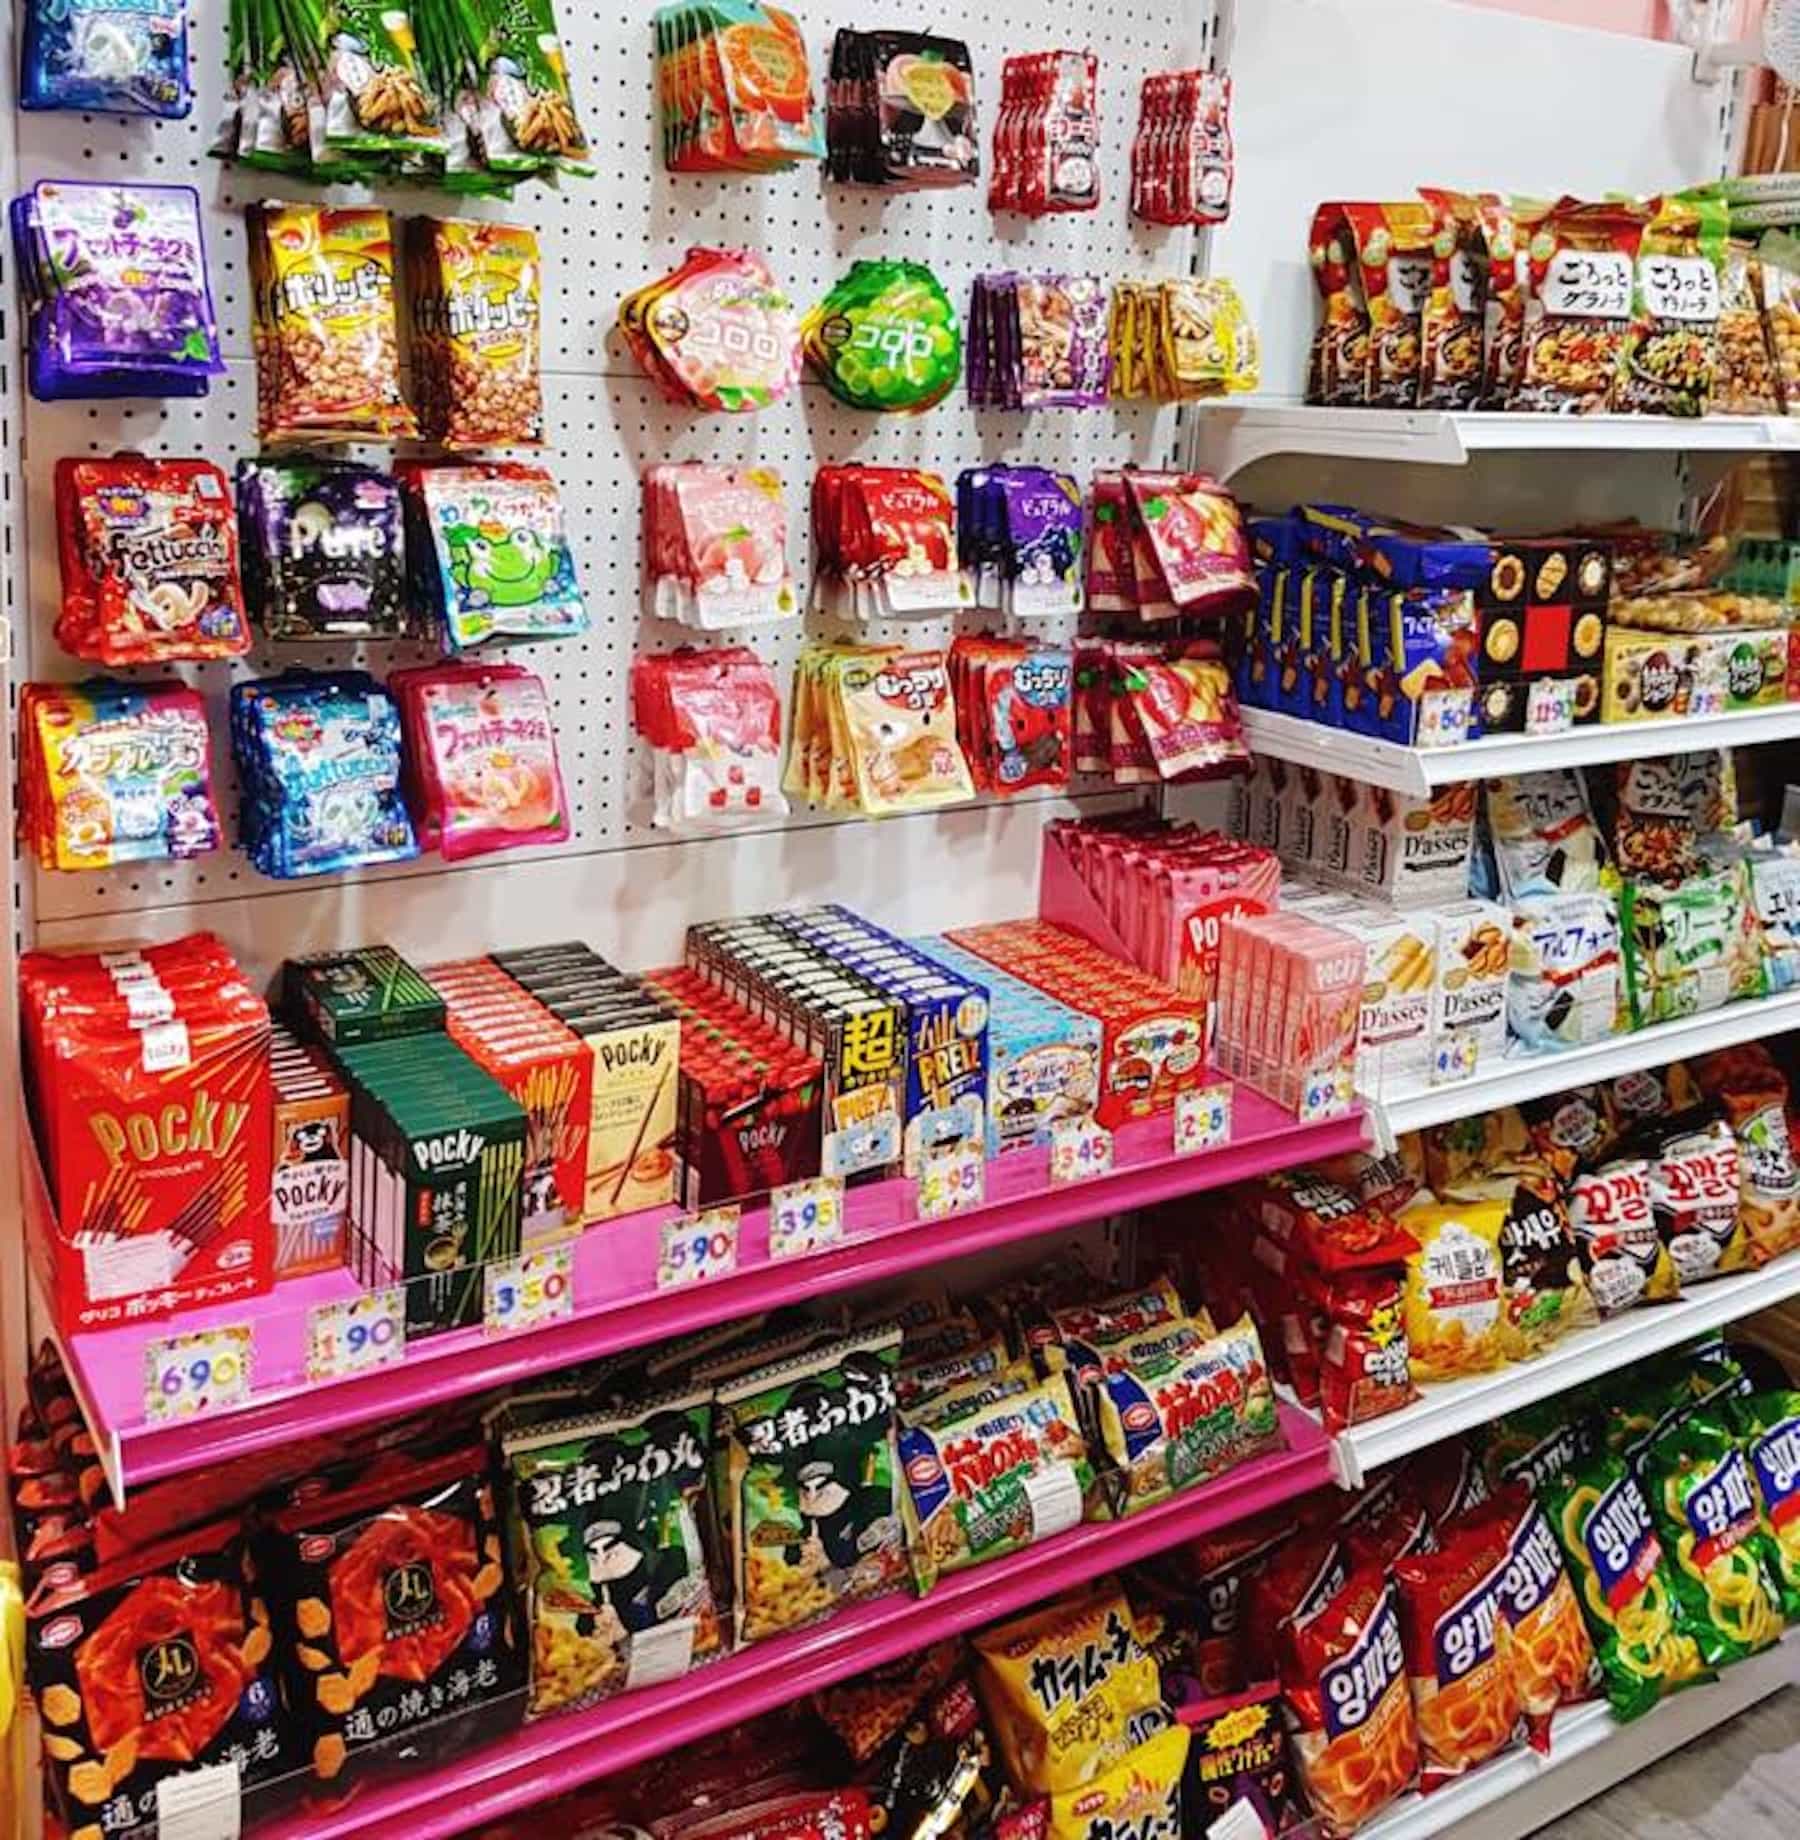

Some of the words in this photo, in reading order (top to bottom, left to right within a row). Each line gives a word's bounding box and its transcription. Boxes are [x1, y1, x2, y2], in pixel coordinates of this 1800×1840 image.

[284, 264, 392, 313] ポリッピー
[1558, 260, 1629, 289] ごろっと
[1648, 263, 1714, 291] ごろっと
[448, 292, 538, 337] ポリッピー
[692, 325, 779, 361] コロロ
[1403, 833, 1470, 858] D'asses
[1359, 1002, 1428, 1032] D'asses
[1444, 988, 1504, 1019] D'asses
[601, 1031, 667, 1072] POCKY
[843, 1007, 895, 1077] 超
[88, 1090, 250, 1168] POCKY
[413, 1129, 485, 1172] POCKY
[275, 1176, 345, 1213] POCKY
[125, 1289, 193, 1318] ポッキー
[530, 1432, 704, 1515] 忍者ふわ丸
[343, 1656, 500, 1743] 通の焼き海老
